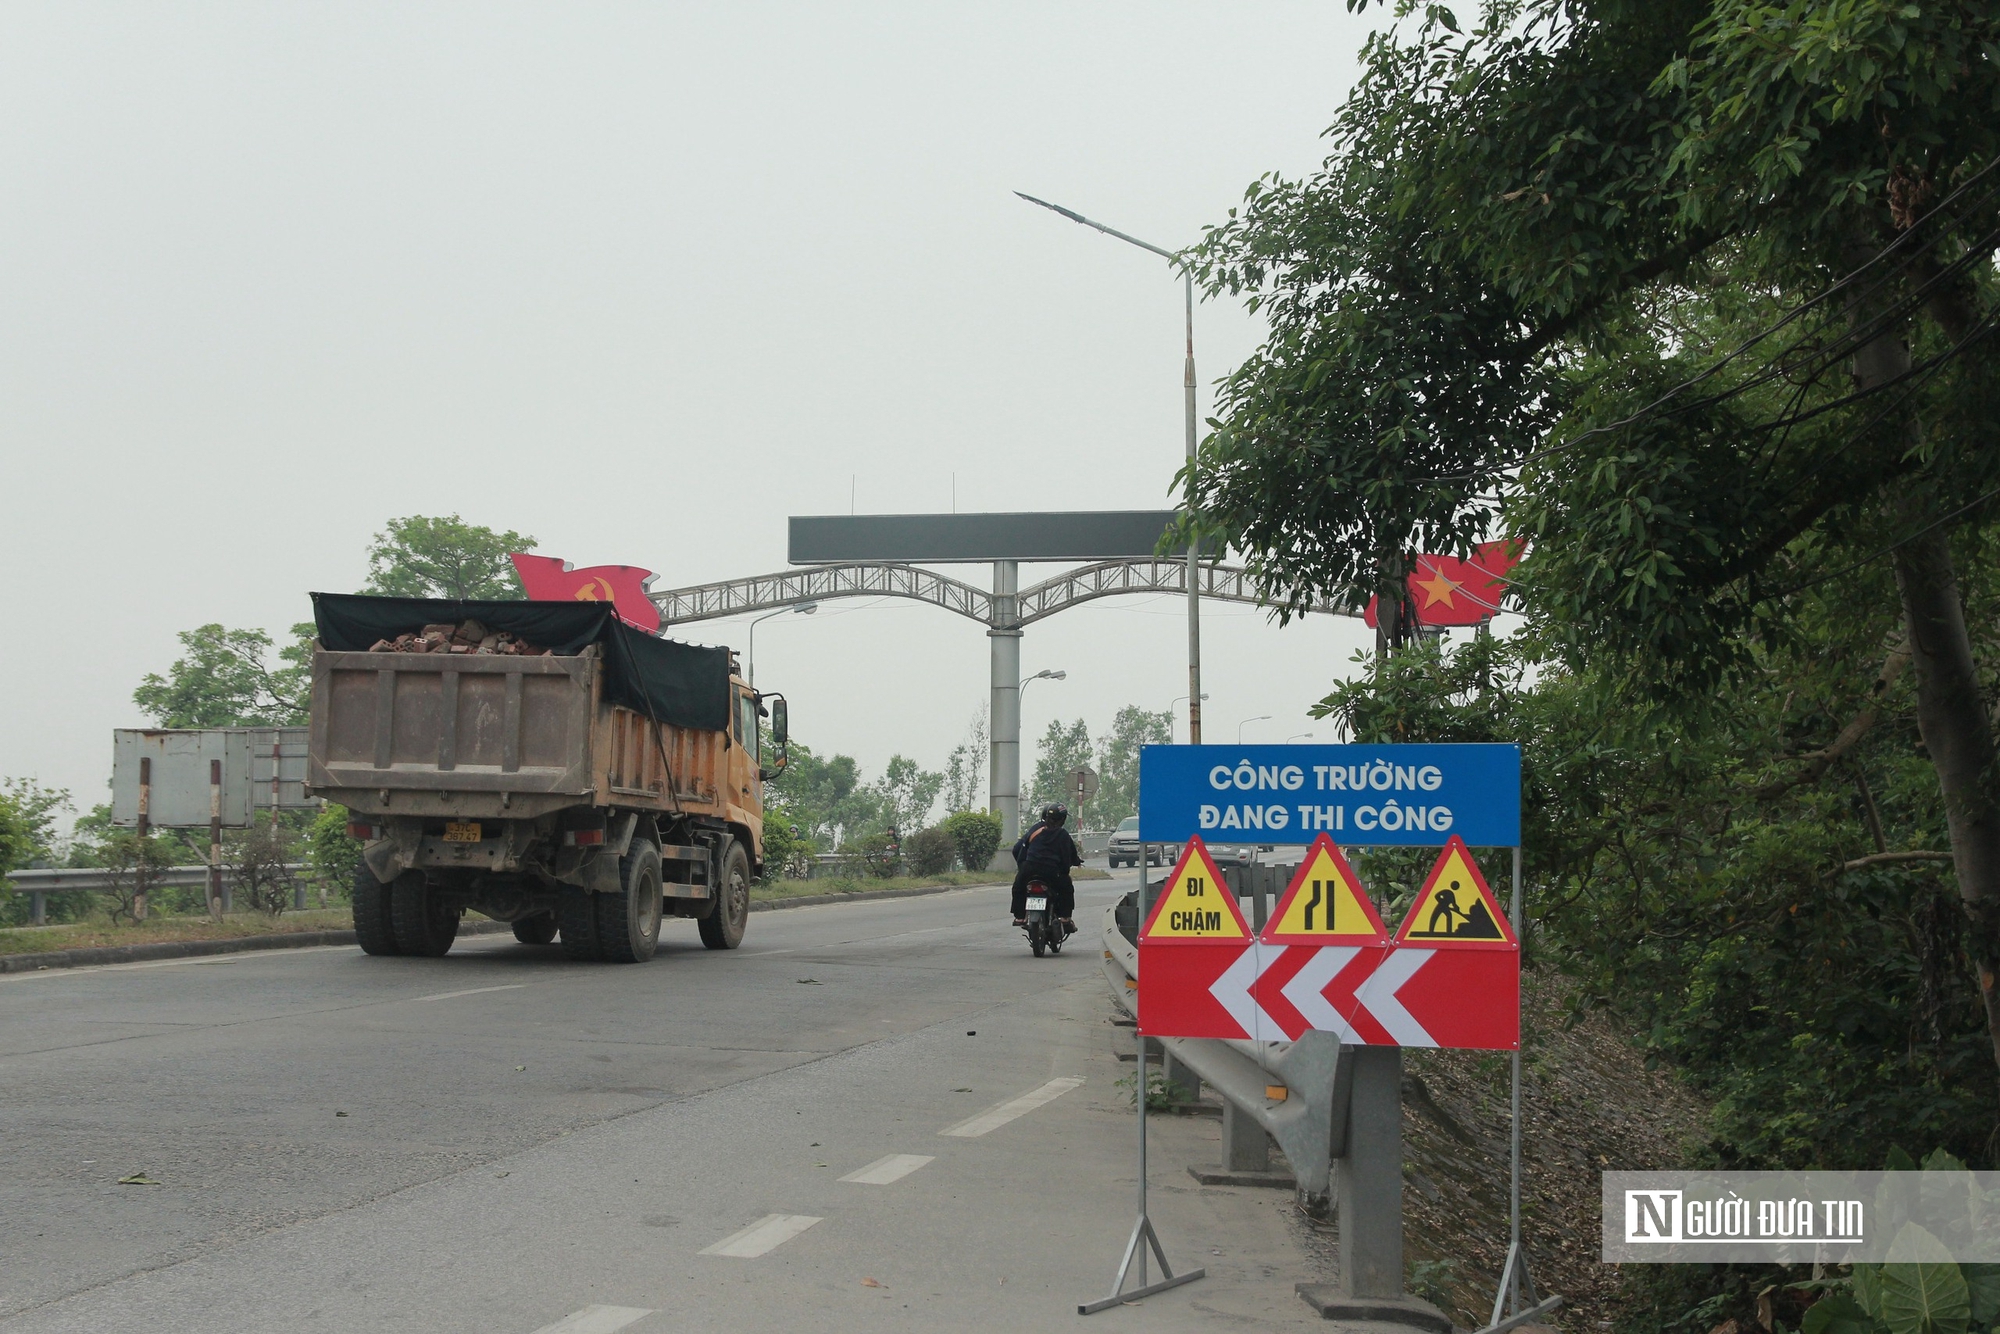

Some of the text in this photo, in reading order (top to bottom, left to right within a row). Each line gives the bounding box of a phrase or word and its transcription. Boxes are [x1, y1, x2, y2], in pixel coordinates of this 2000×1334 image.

[1209, 758, 1443, 791] CÔNG TRƯỜNG
[1199, 799, 1453, 831] ĐANG THI CÔNG
[1186, 877, 1204, 897] ĐI
[1170, 907, 1221, 935] CHẬM
